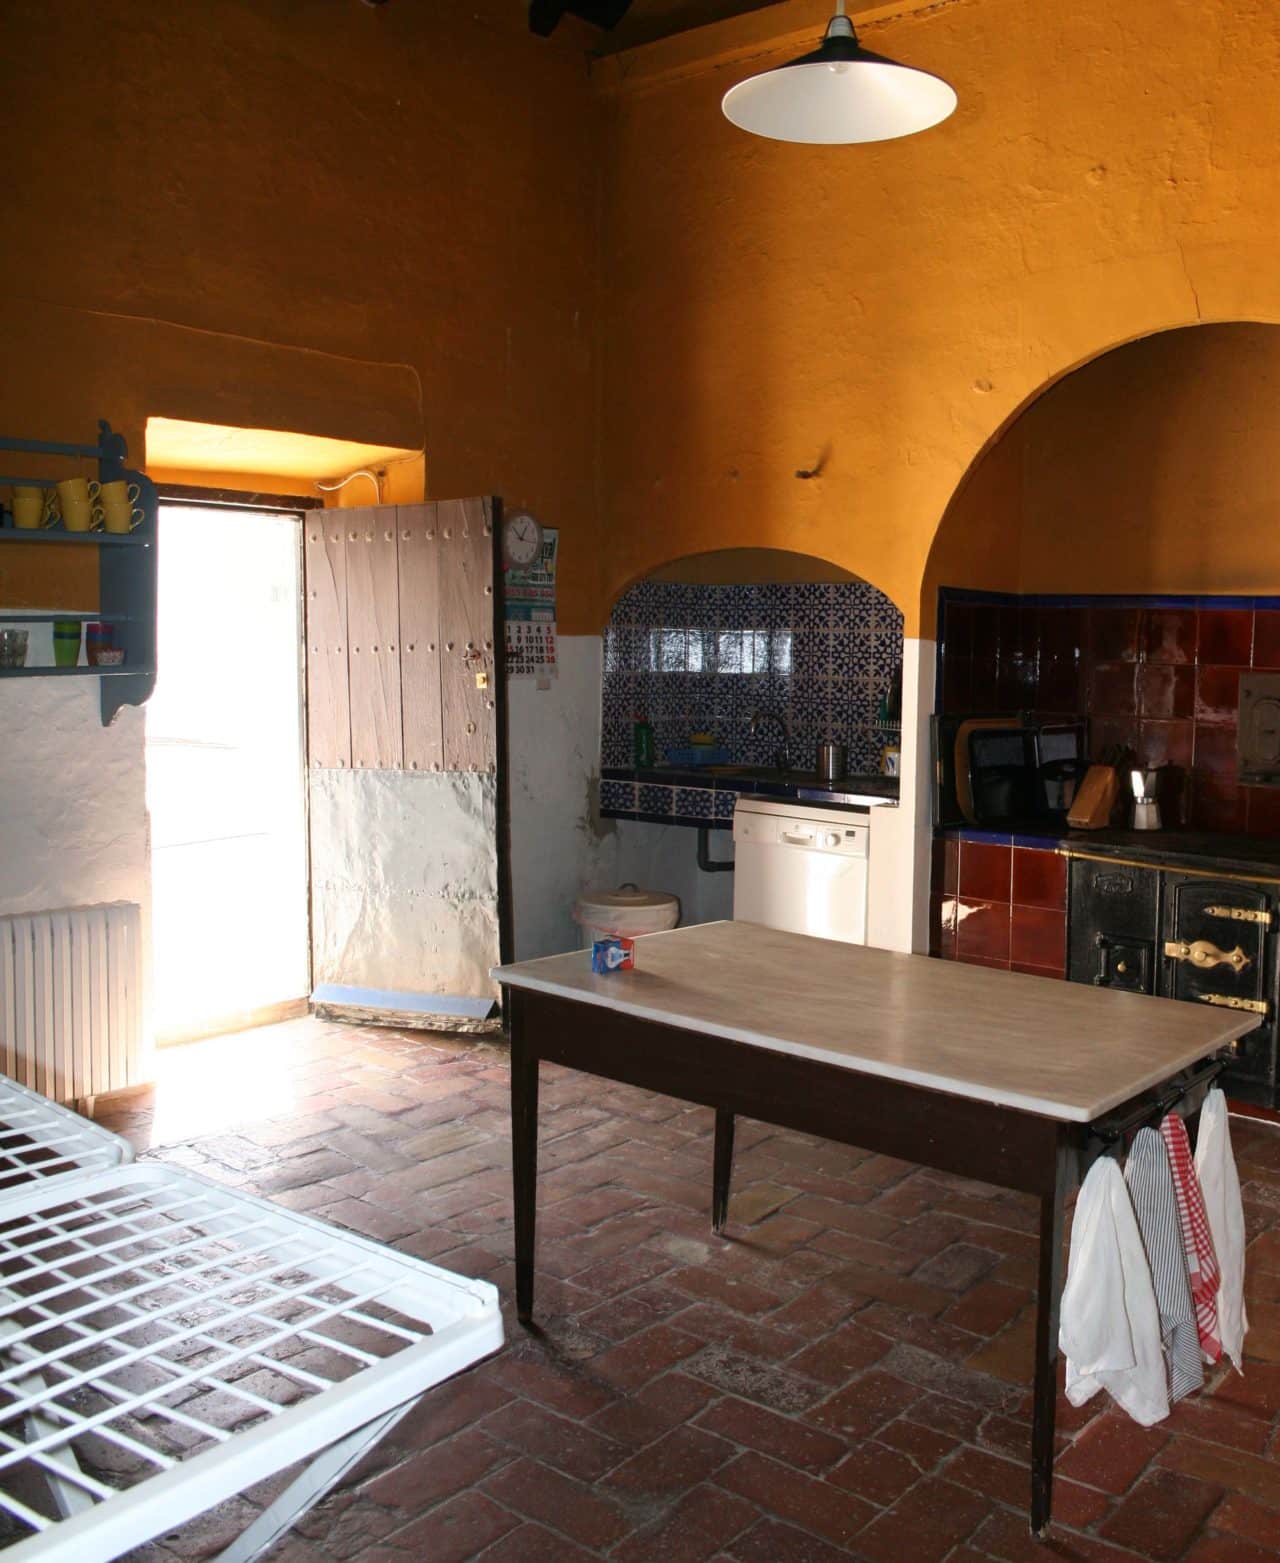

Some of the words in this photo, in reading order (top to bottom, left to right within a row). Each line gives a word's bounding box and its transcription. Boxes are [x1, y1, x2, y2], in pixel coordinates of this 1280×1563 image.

[525, 636, 534, 644] 10
[534, 636, 543, 644] 11
[545, 636, 554, 644] 12
[525, 645, 534, 654] 17
[534, 645, 544, 654] 18
[545, 645, 555, 654] 19
[525, 655, 535, 663] 24
[534, 655, 545, 663] 25
[515, 665, 525, 673] 30
[525, 665, 535, 673] 31
